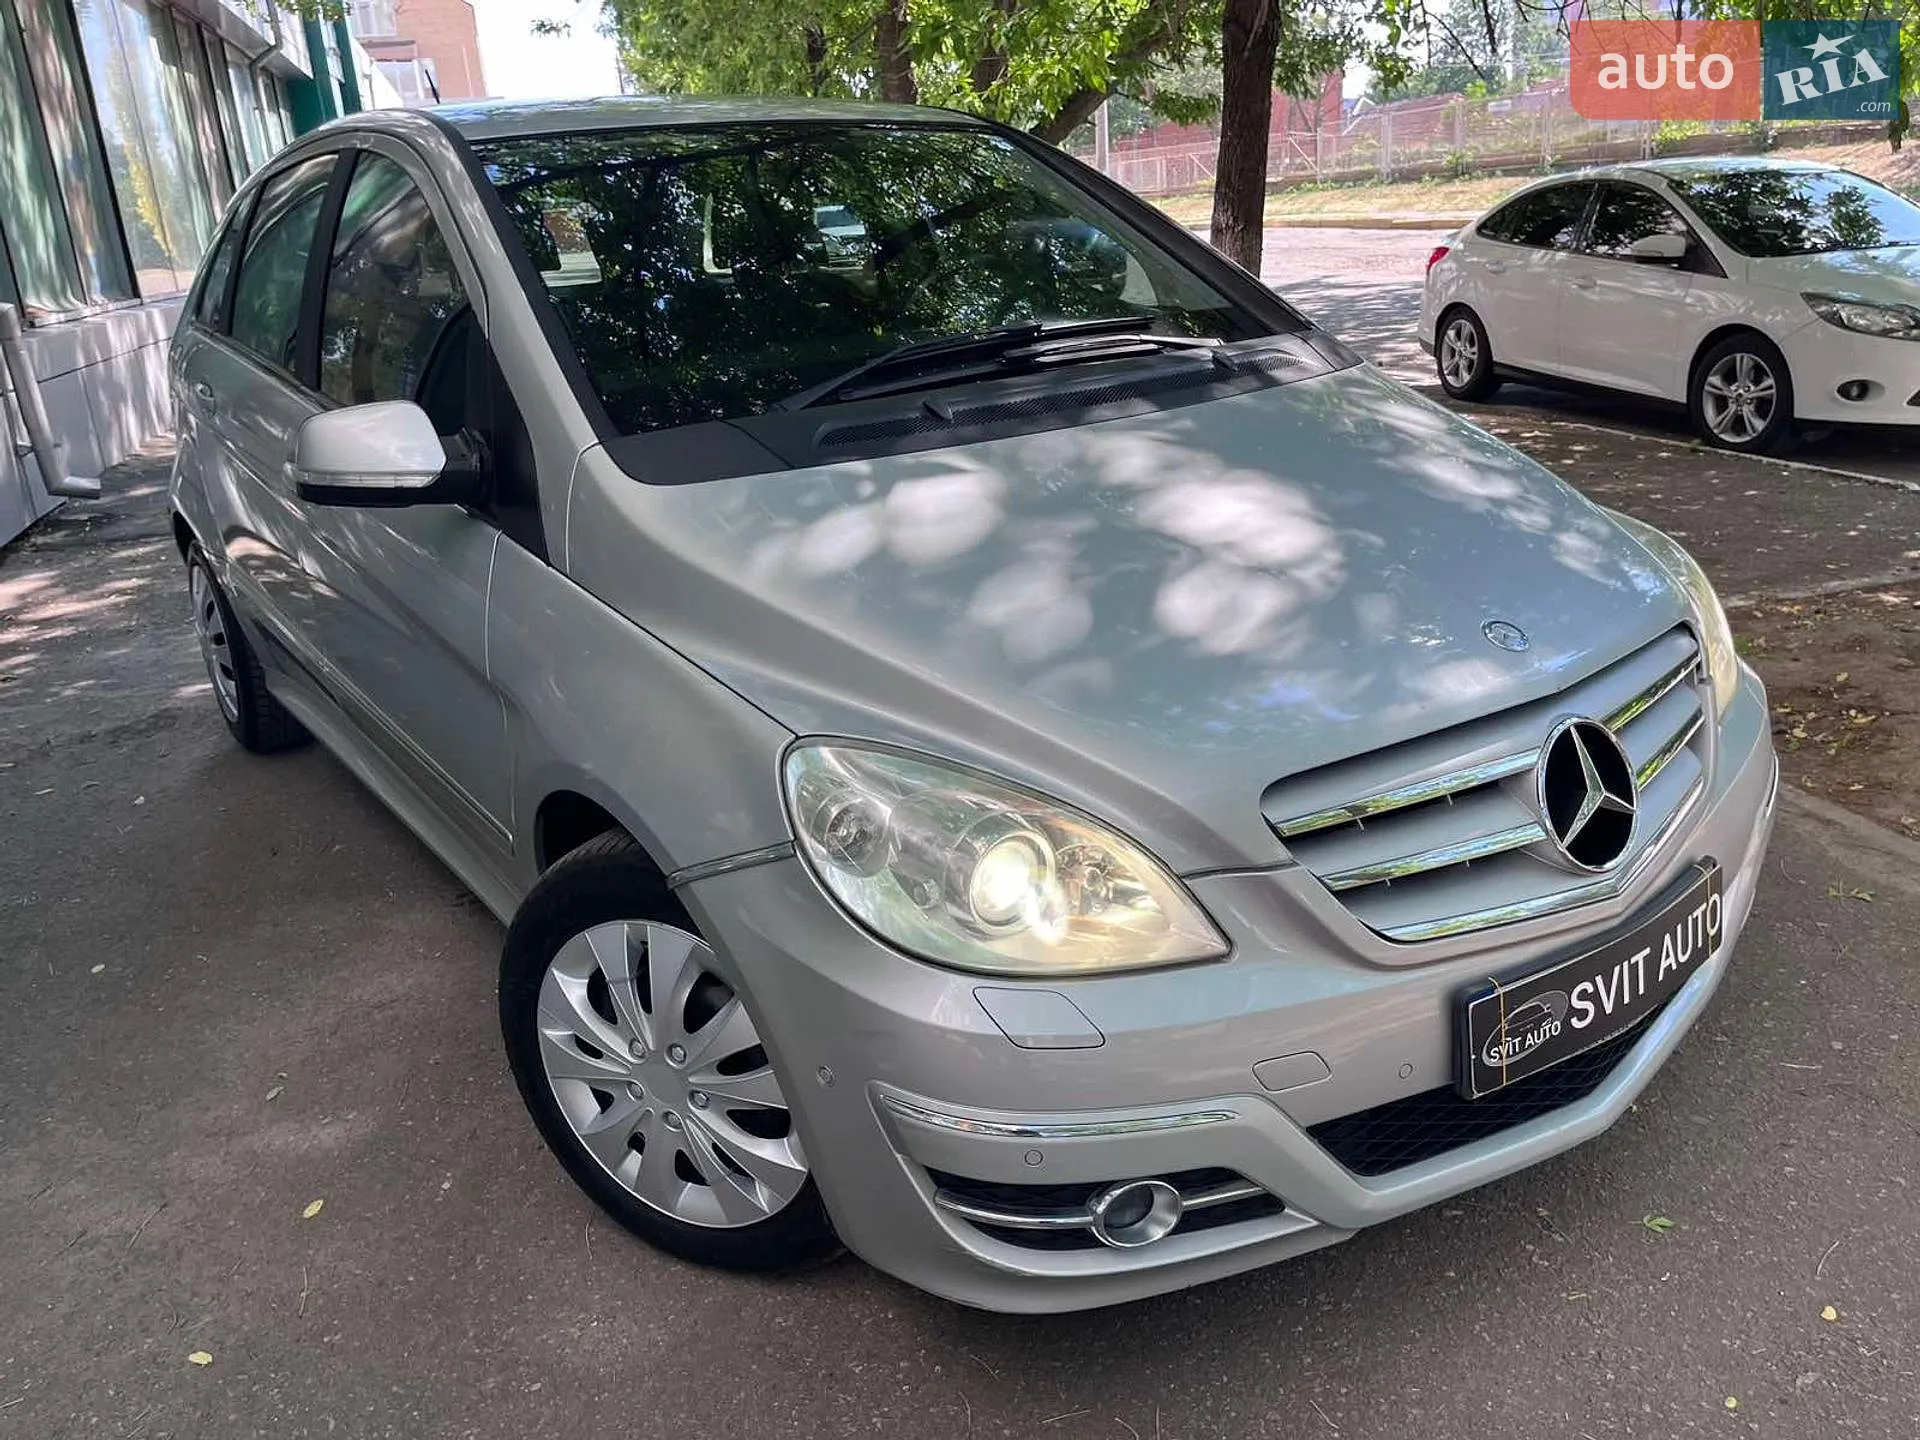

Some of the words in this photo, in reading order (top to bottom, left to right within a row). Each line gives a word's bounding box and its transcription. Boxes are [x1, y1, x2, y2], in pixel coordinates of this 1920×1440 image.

[1570, 947, 1650, 1029] SVIT
[1658, 893, 1720, 982] AUTO
[1490, 1037, 1523, 1062] SVIT
[1524, 1020, 1561, 1049] AUTO
